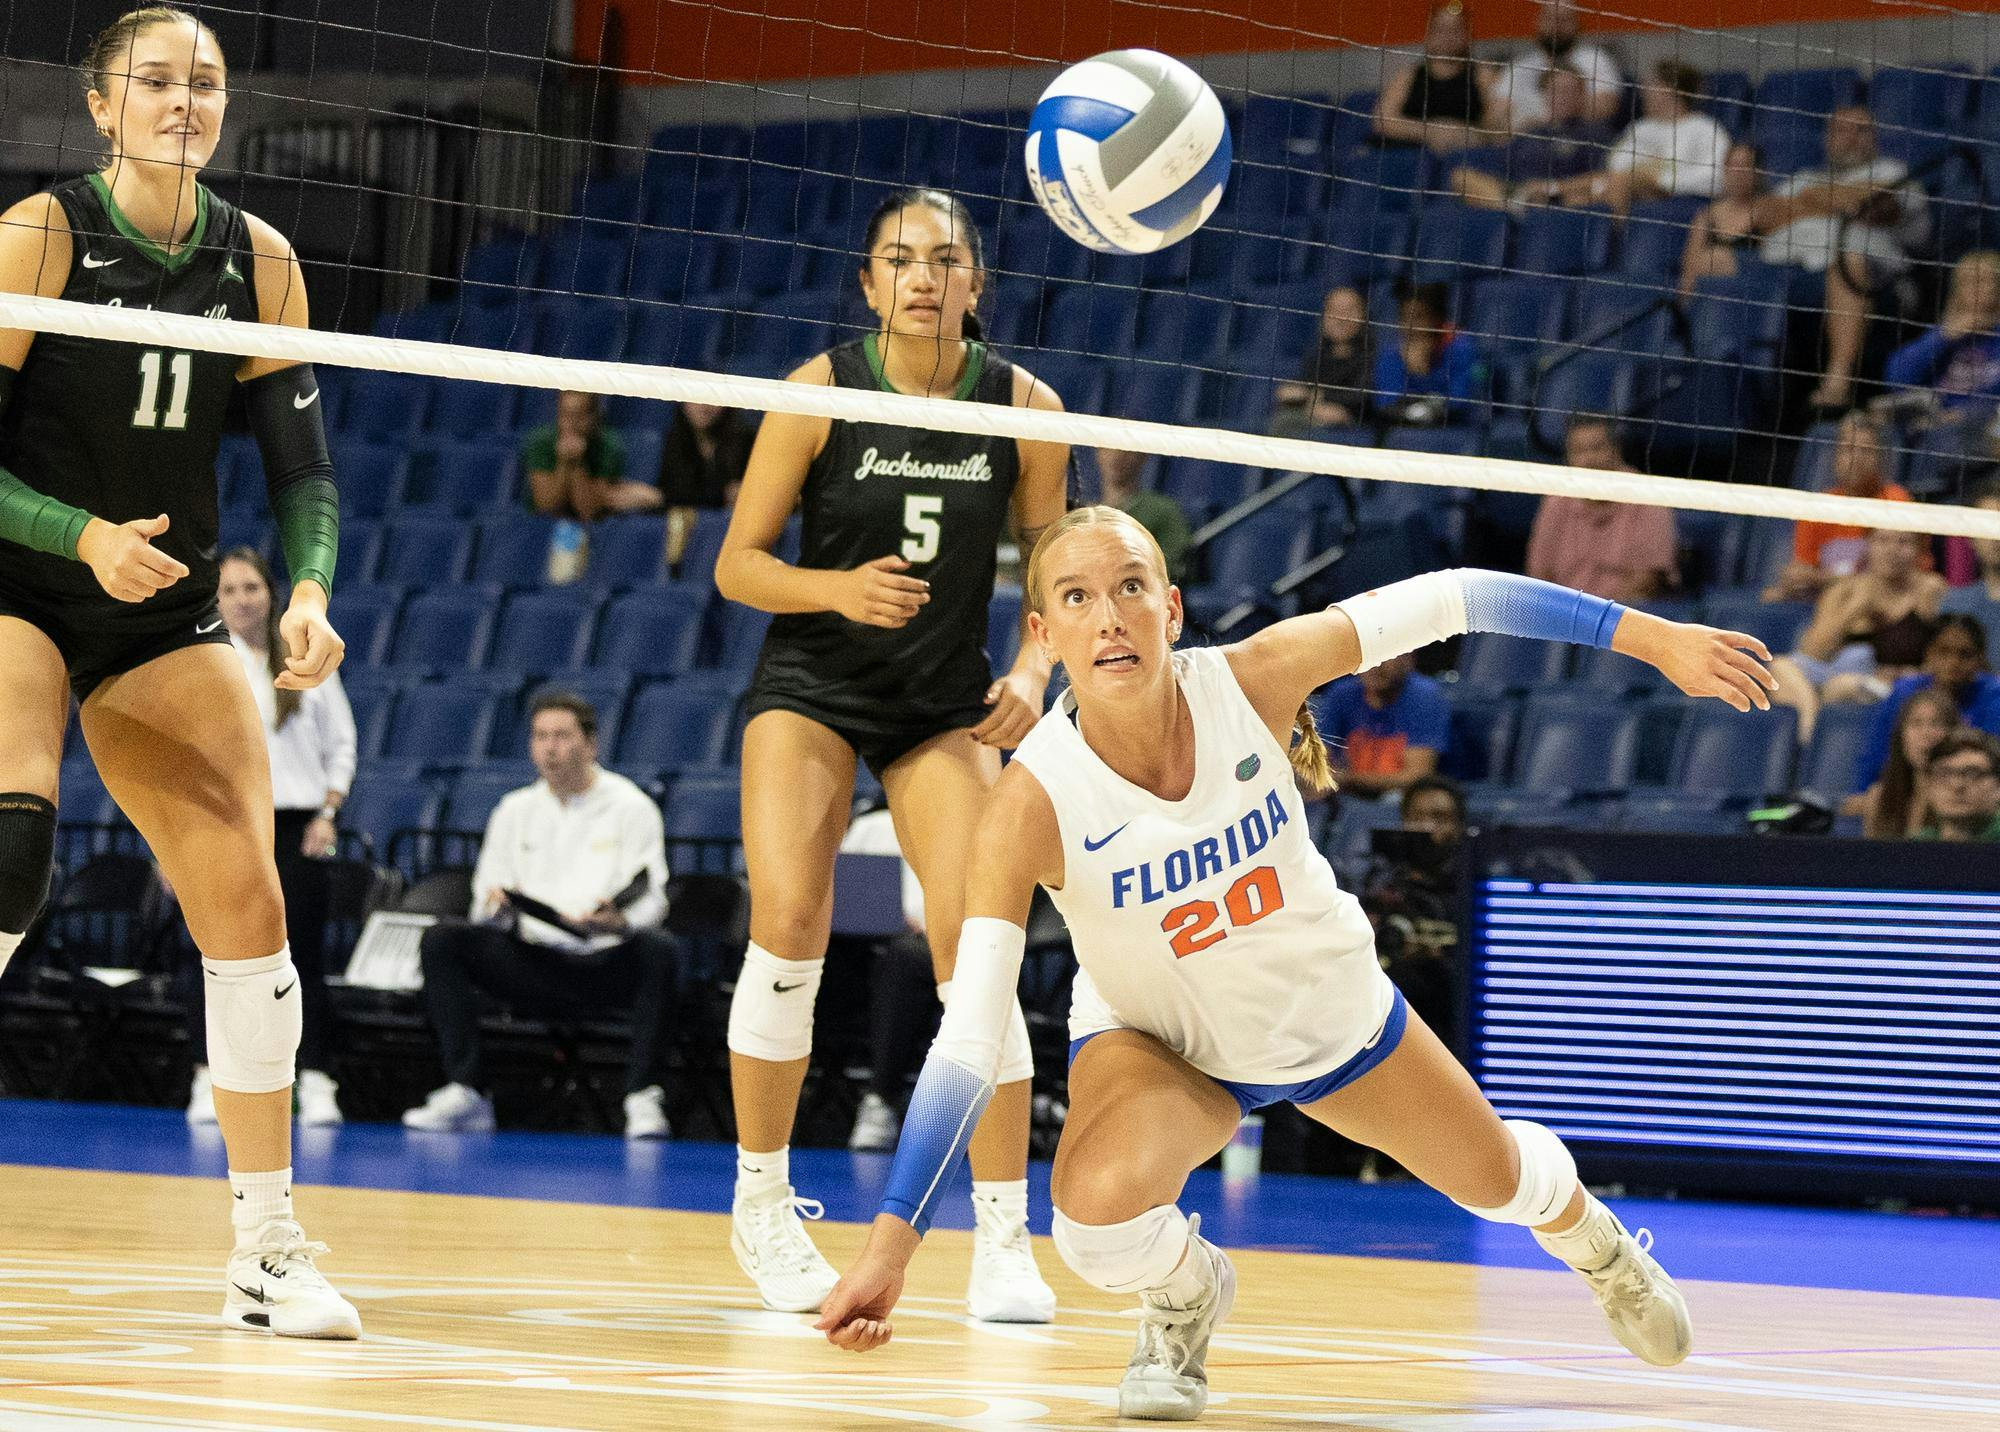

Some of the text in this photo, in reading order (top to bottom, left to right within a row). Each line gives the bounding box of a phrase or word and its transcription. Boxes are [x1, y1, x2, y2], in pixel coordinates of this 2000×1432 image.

[130, 350, 192, 431] 11
[854, 447, 993, 482] Jacksonville
[901, 493, 943, 563] 5
[1111, 788, 1289, 909] FLORIDA
[1160, 865, 1285, 960] 20
